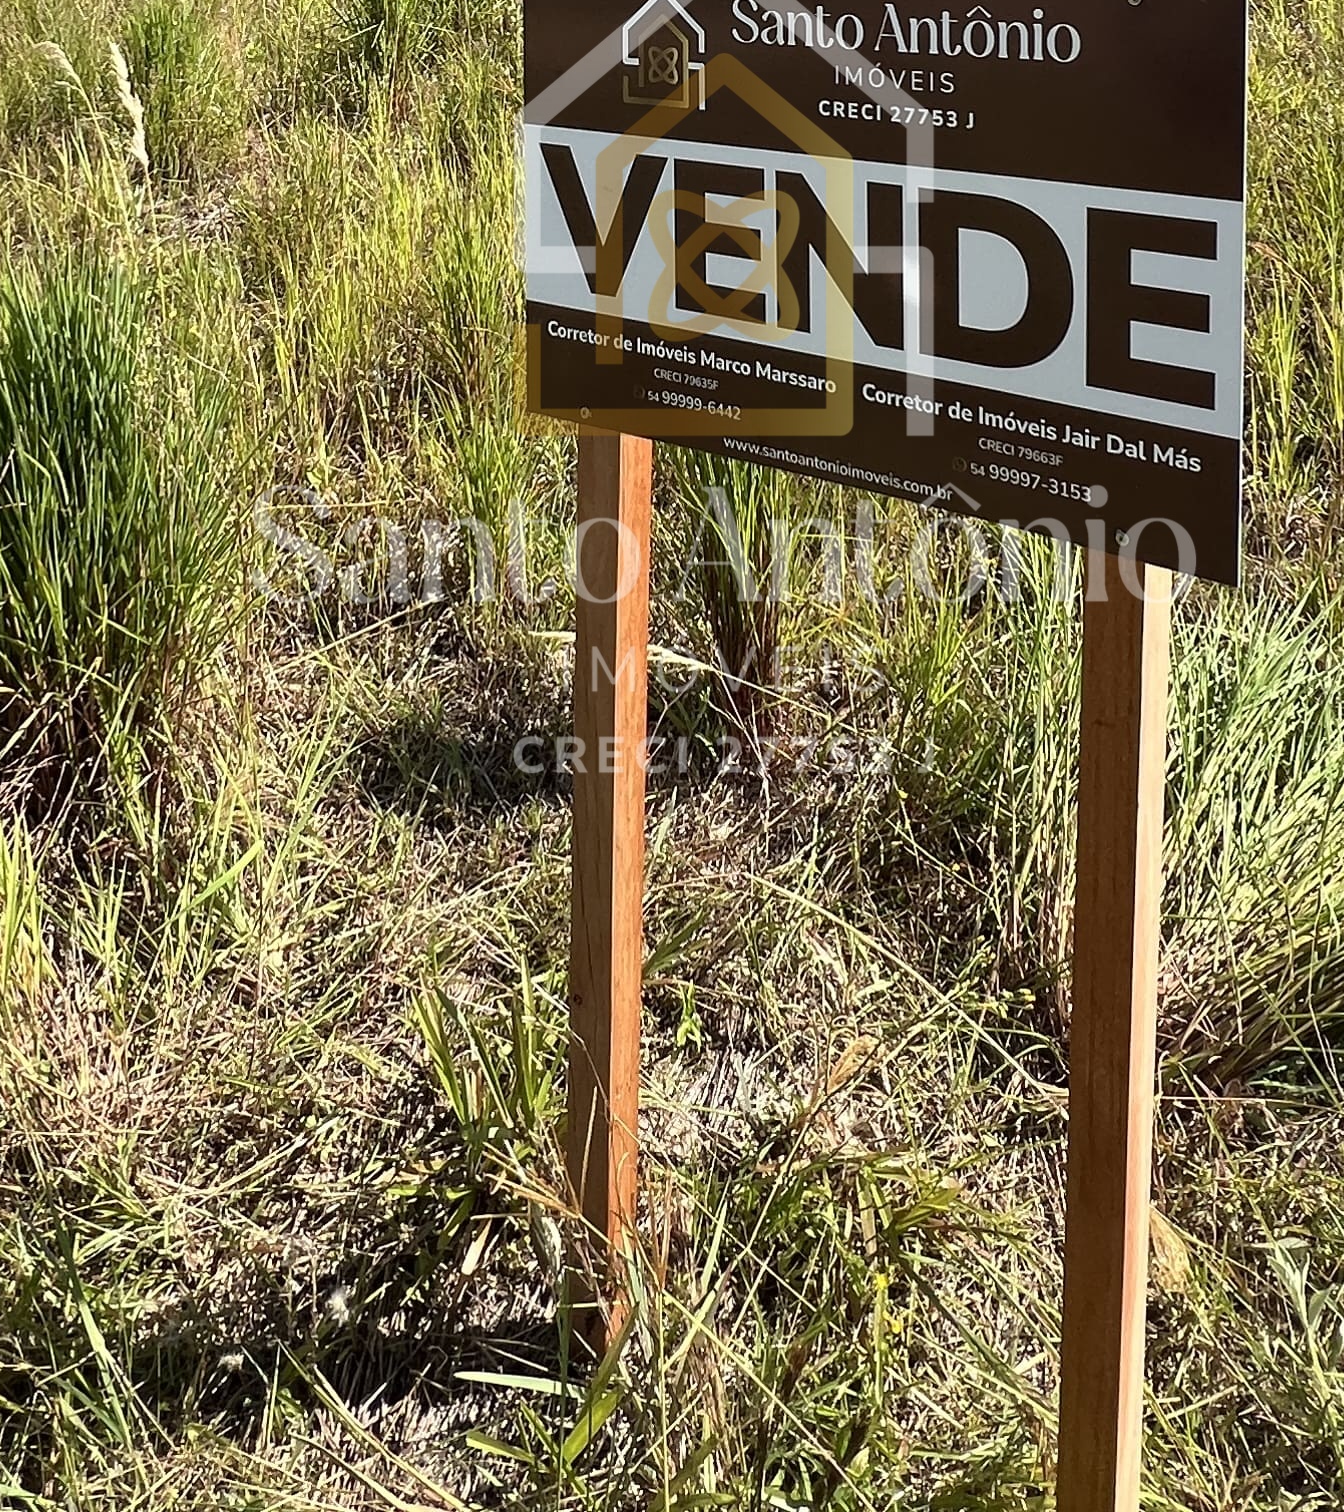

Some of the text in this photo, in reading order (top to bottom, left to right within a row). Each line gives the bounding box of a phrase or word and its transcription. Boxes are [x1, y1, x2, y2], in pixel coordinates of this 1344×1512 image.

[874, 3, 1081, 63] Antônio
[834, 63, 955, 93] IMÓVEIS
[818, 100, 975, 130] CRECI 27753 J
[539, 142, 1218, 411] VENDE
[547, 321, 837, 394] Corretor de Imóveis Marco Marssaro
[653, 367, 682, 383] CRECI
[647, 390, 742, 421] 54 99999-6442
[862, 383, 1202, 473] Corretor de Imóveis Jair Dal Más
[978, 438, 1015, 457] CRECI
[722, 436, 953, 502] www.santoantonioimoveis.com.br
[970, 463, 1093, 503] 54 99997-3153
